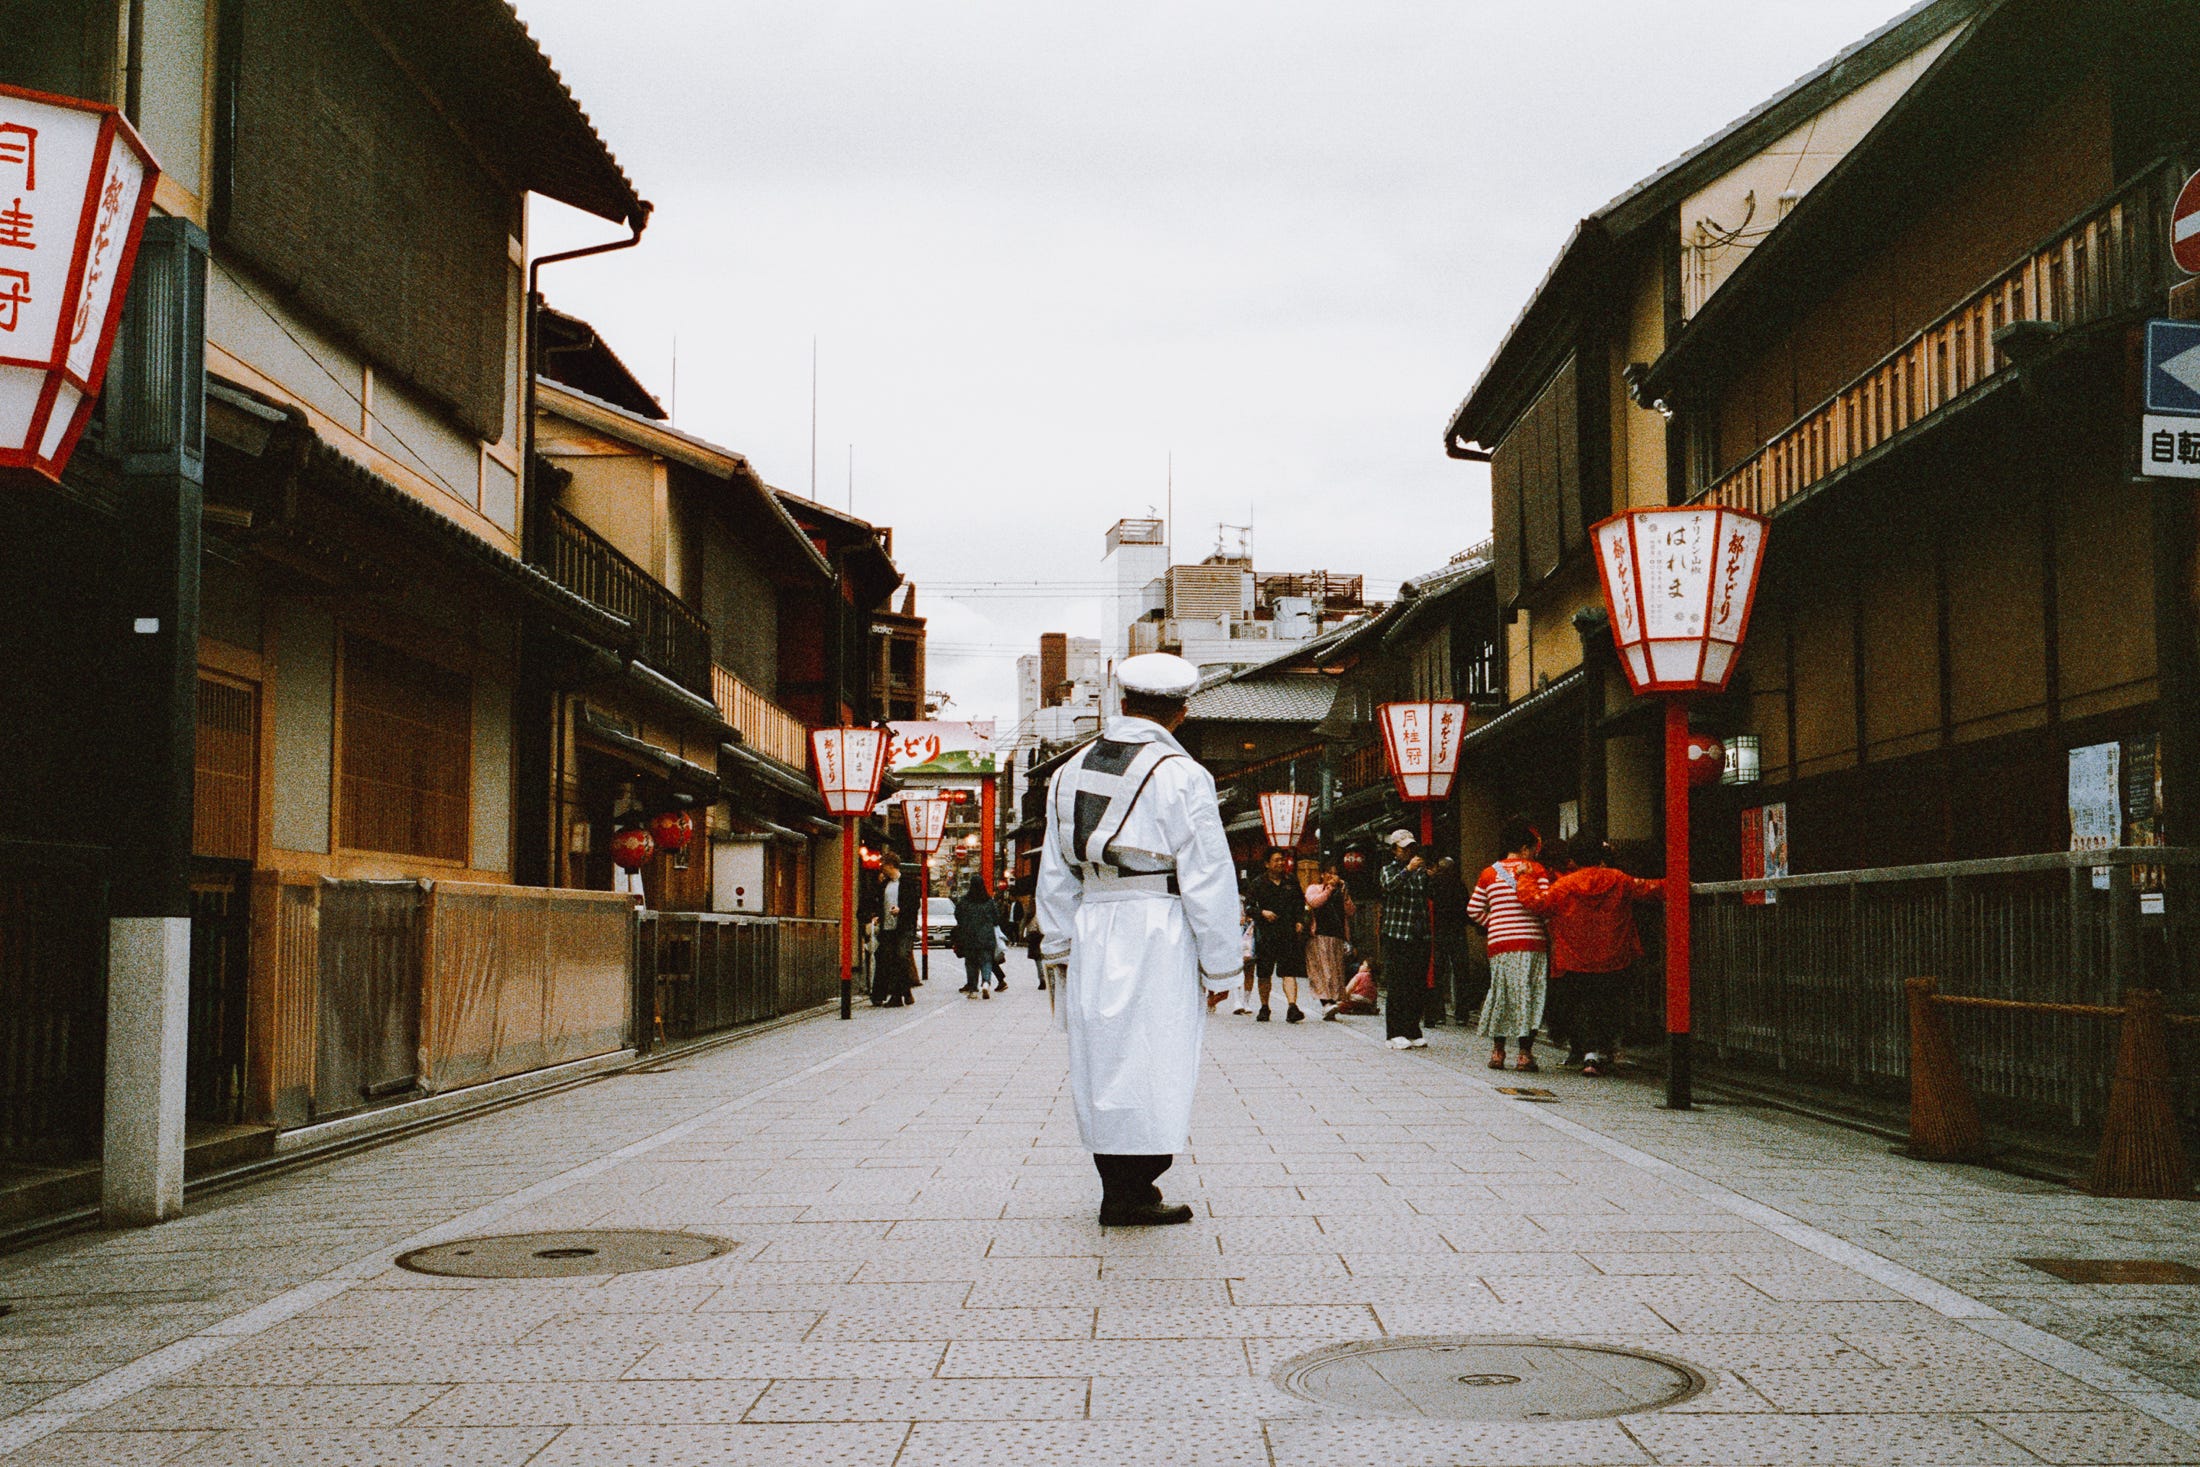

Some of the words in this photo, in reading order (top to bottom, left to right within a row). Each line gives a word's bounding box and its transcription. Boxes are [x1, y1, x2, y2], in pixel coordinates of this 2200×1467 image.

[2152, 429, 2200, 464] 自転
[1666, 526, 1687, 599] はれま
[1717, 528, 1746, 626] 都をどり
[1403, 710, 1422, 765] 月桂冠
[1438, 711, 1453, 764] 都をどり
